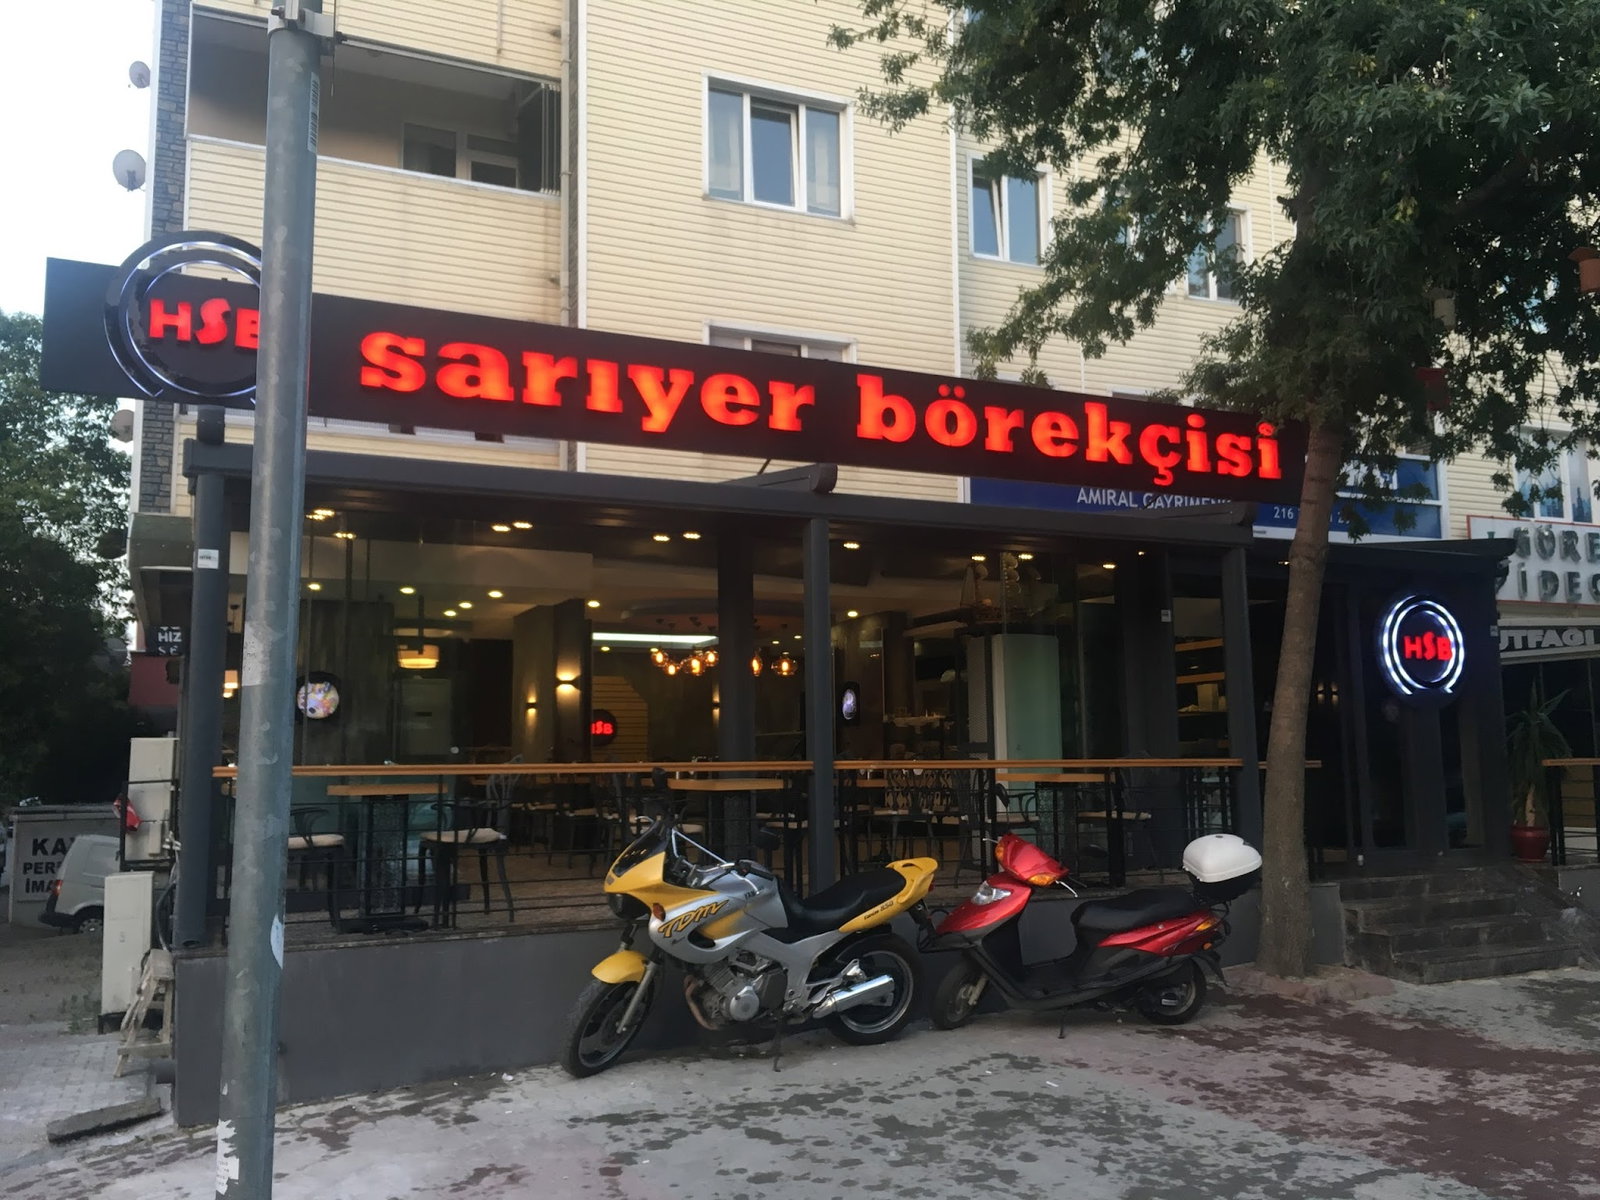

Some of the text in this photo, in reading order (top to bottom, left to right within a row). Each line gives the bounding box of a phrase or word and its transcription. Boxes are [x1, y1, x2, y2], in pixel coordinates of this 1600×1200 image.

[360, 331, 1282, 487] sarıyer börekçisi
[1273, 506, 1294, 520] 216
[1403, 631, 1453, 661] HSB
[32, 838, 75, 856] KA
